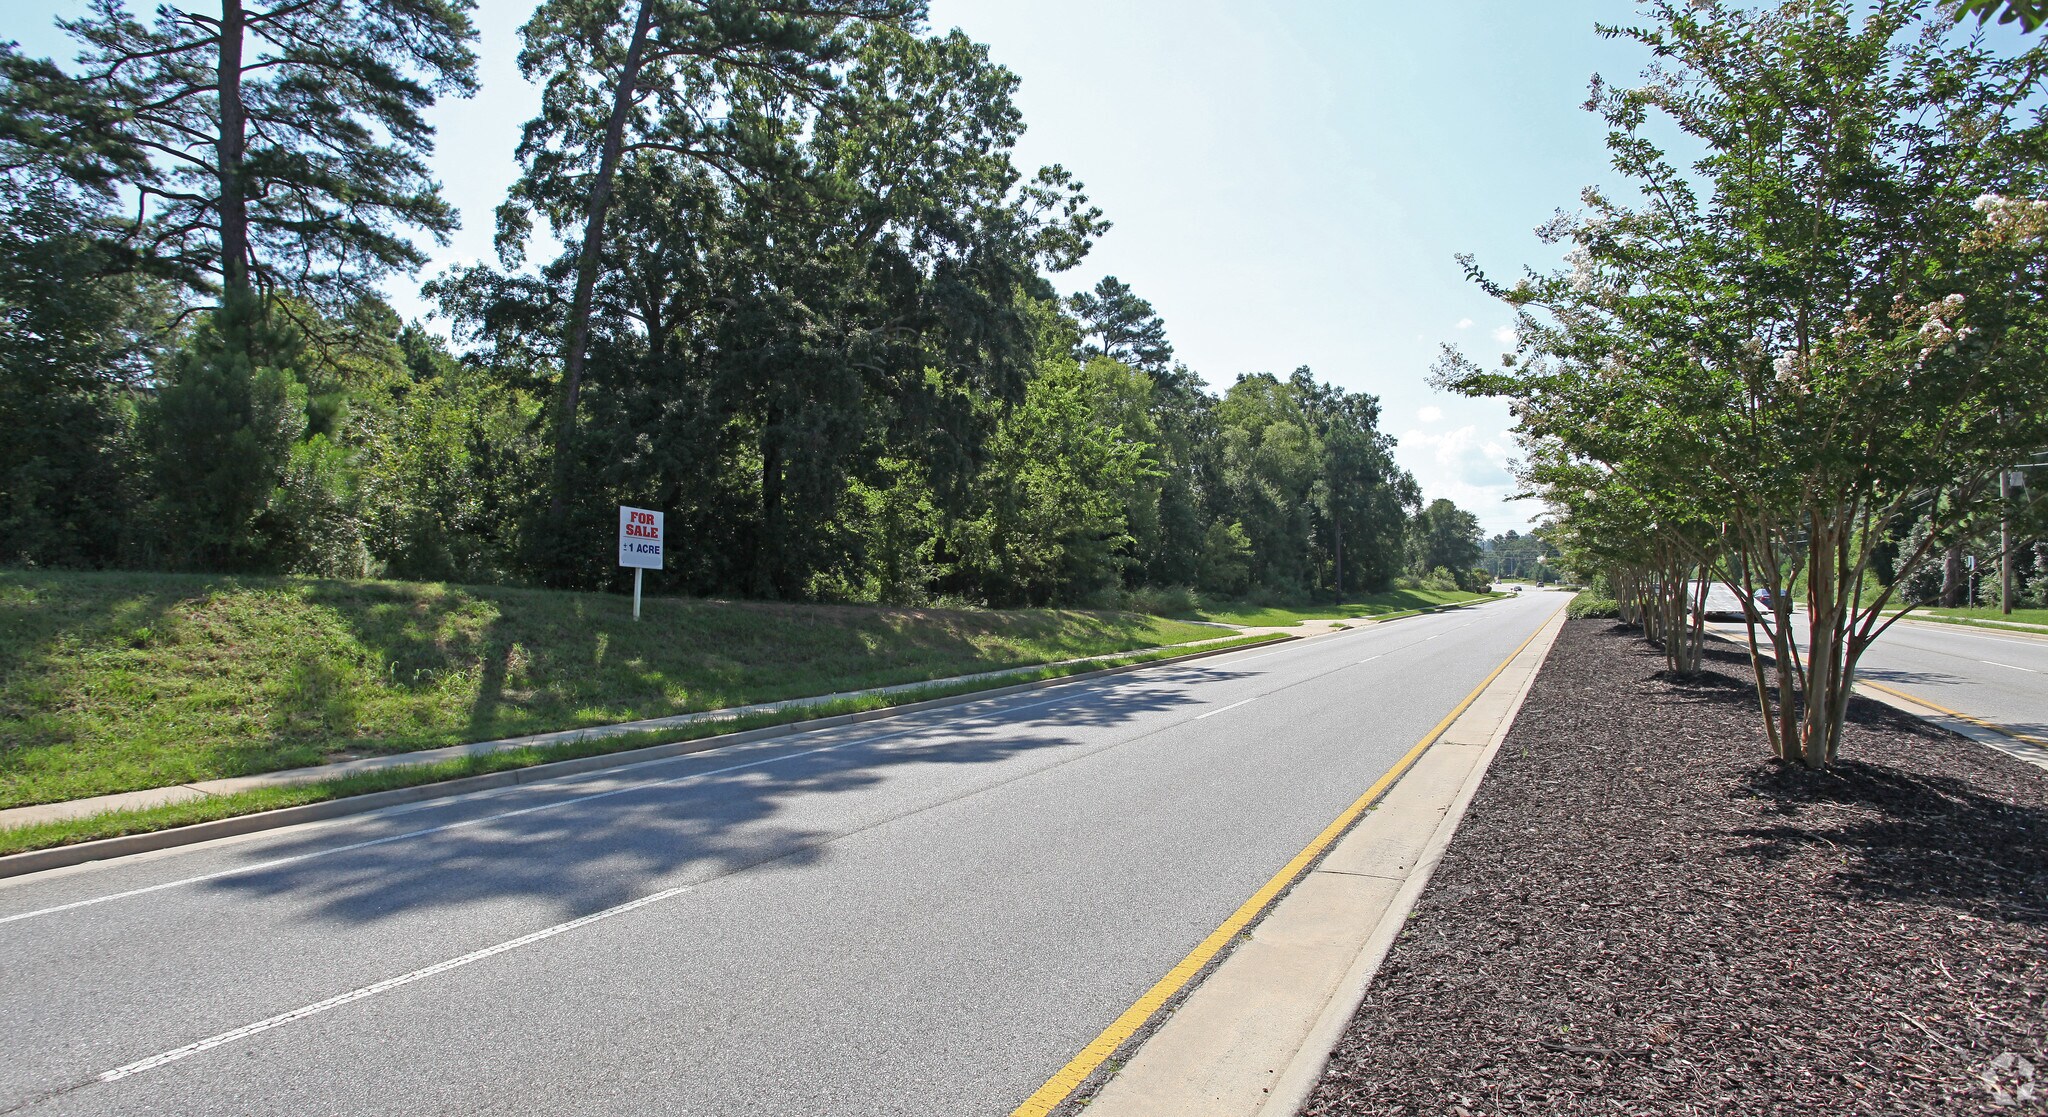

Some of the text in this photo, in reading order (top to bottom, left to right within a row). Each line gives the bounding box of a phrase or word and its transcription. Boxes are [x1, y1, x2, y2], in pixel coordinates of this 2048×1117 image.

[630, 511, 655, 525] FOR
[626, 524, 659, 538] SALE
[636, 544, 660, 555] ACRE
